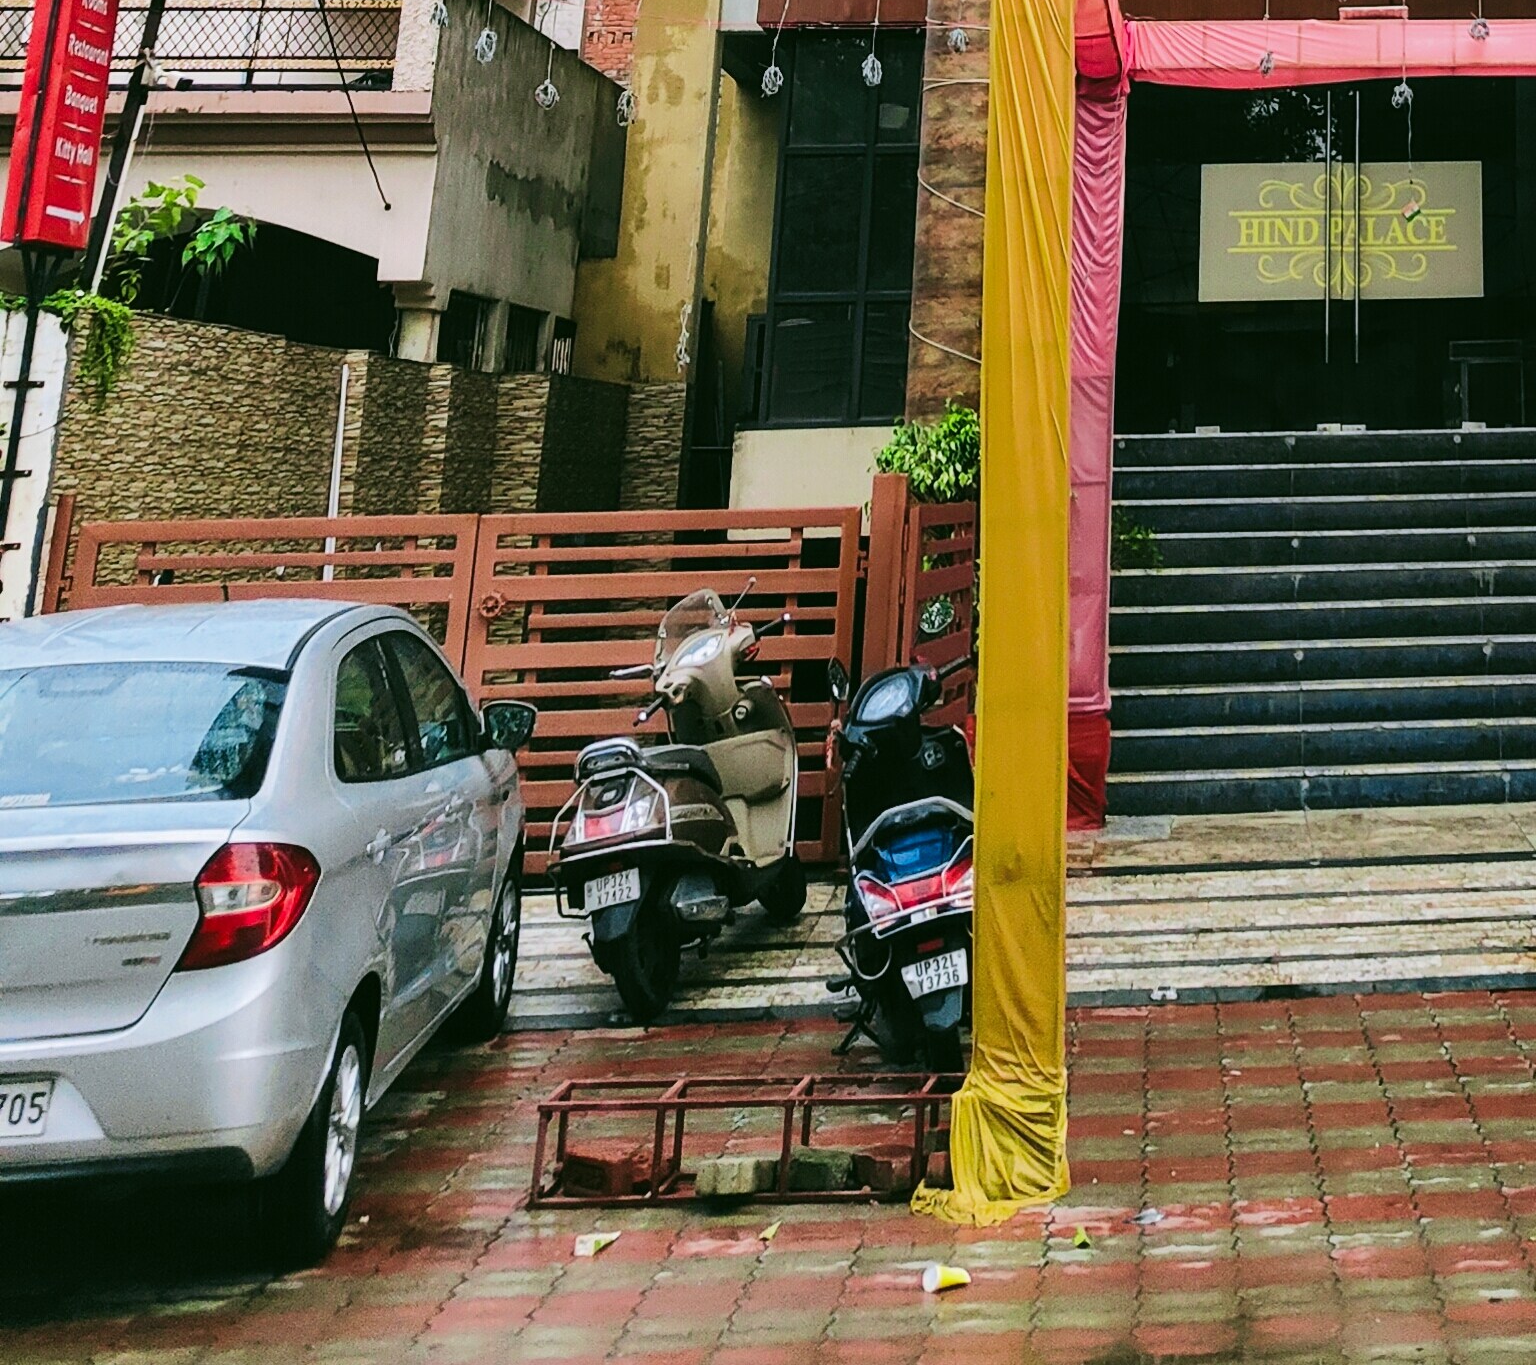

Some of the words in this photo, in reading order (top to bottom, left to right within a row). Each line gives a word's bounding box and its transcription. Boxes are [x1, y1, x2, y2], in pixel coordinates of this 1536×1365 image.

[68, 33, 110, 67] Restaurant
[64, 84, 98, 114] Banquet
[55, 136, 77, 167] Kitty
[76, 142, 94, 166] Hall
[1236, 217, 1320, 247] HIND
[1331, 216, 1447, 246] PALACE
[915, 953, 958, 977] UP32L
[917, 969, 960, 993] Y3736
